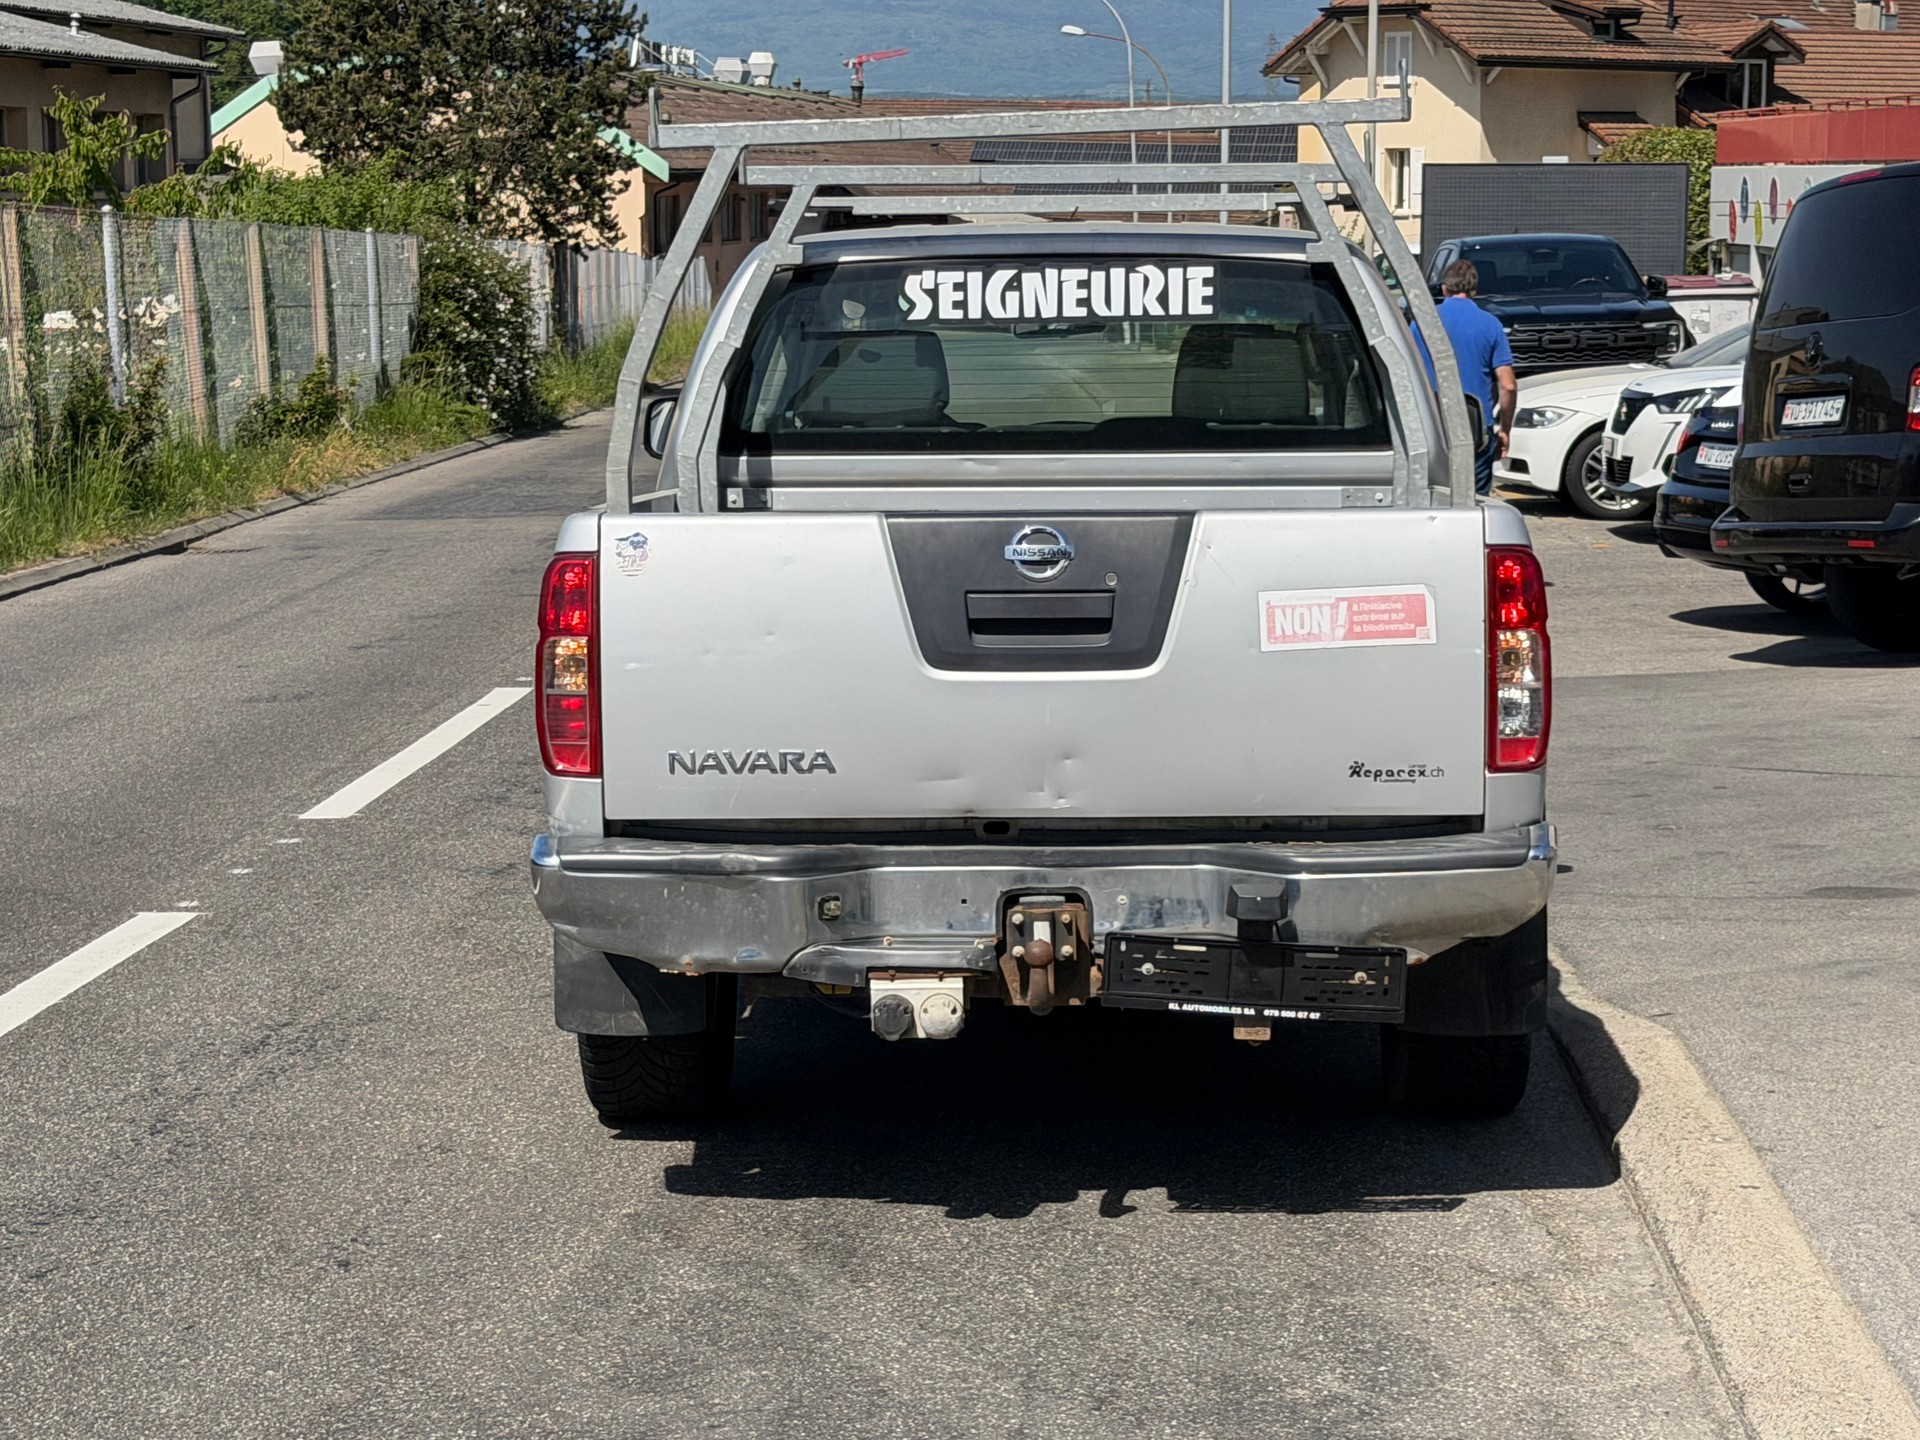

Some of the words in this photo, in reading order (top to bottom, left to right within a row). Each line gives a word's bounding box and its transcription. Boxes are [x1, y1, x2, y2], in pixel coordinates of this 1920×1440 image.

[898, 265, 1214, 321] SEIGNEURIE
[1012, 547, 1068, 557] NISSAN
[1353, 623, 1362, 633] la
[668, 749, 837, 776] NAVARA
[1348, 761, 1445, 782] Reparex.ch
[1182, 1003, 1242, 1014] AUTOMOBILES
